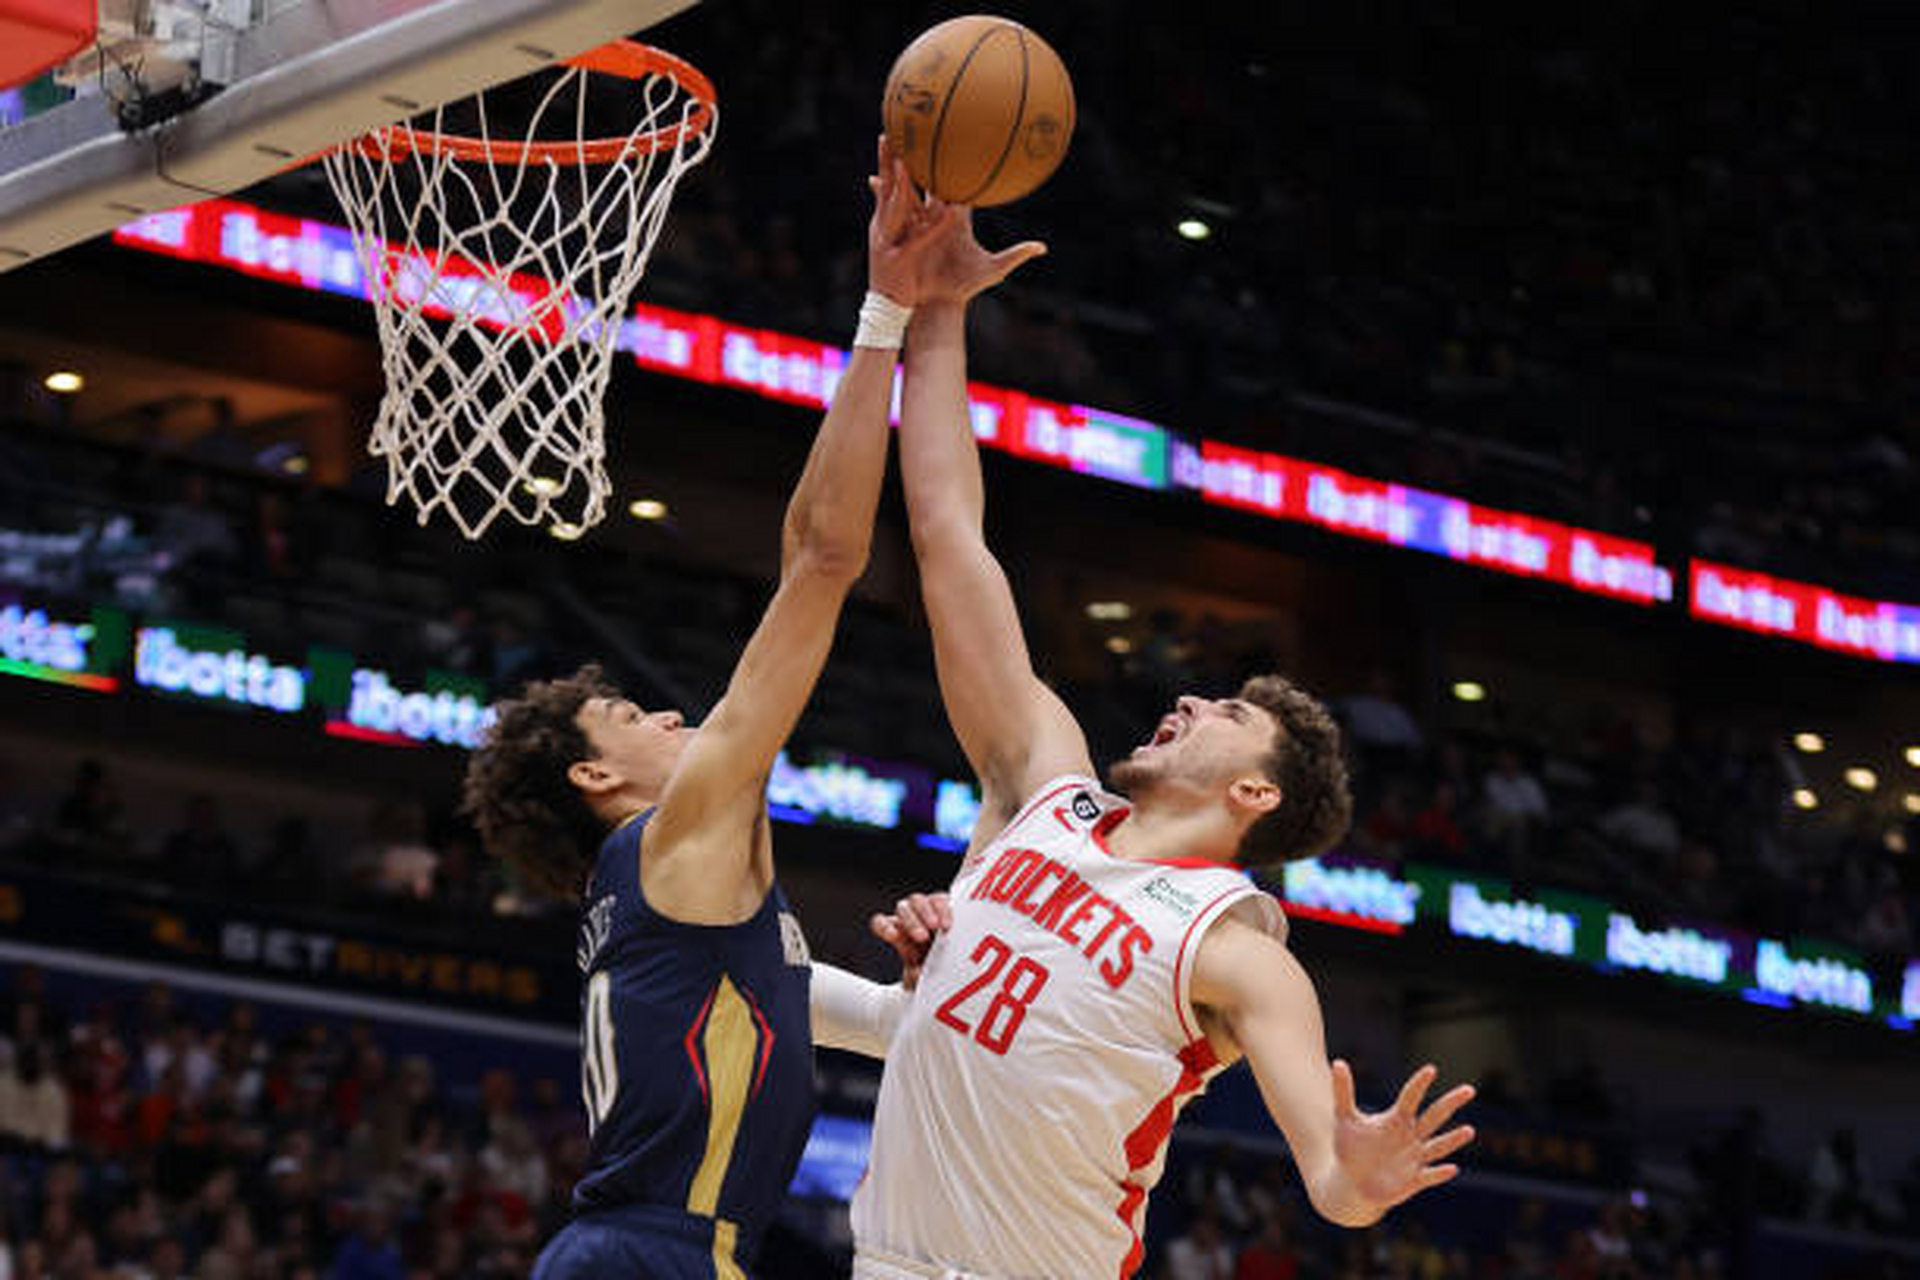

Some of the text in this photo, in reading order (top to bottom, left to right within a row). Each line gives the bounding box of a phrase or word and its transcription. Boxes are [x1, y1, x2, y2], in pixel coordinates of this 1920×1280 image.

[135, 627, 304, 711] ibotta
[969, 847, 1153, 989] ROCKETS
[935, 933, 1049, 1056] 28
